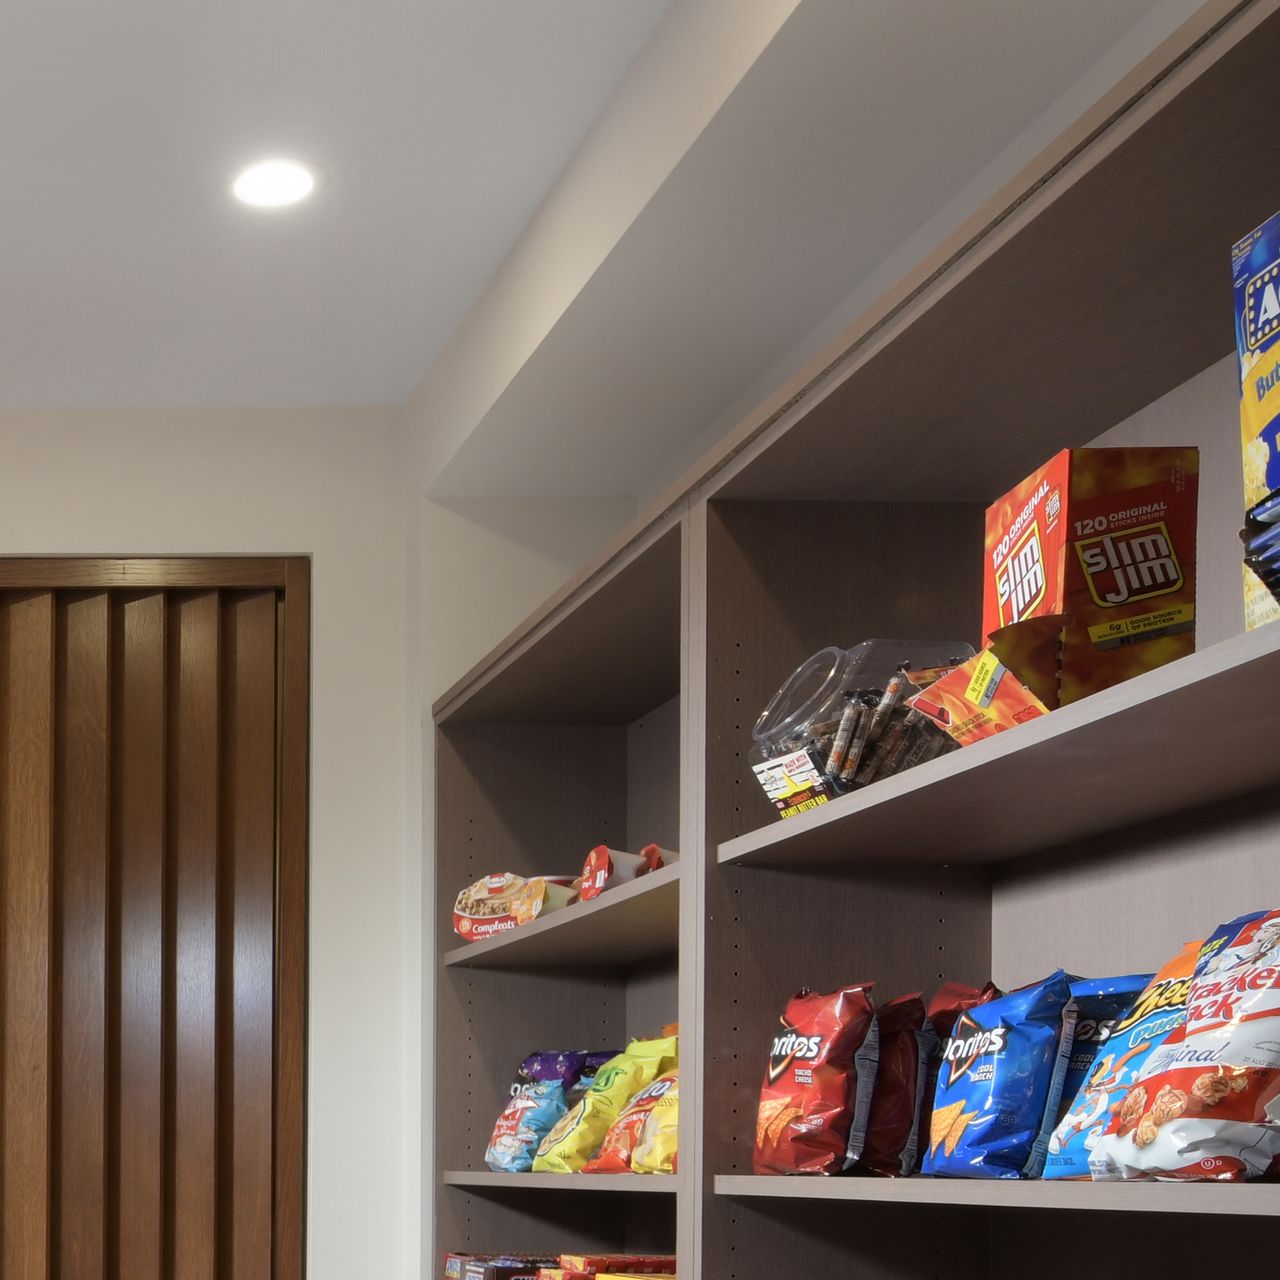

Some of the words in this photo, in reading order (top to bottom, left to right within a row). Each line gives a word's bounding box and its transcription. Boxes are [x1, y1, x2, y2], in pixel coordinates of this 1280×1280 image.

[992, 535, 1010, 569] 120
[1009, 480, 1050, 538] ORIGINAL
[1074, 516, 1107, 536] 120
[1109, 502, 1167, 521] ORIGINAL
[1110, 517, 1136, 528] STICKS
[1139, 511, 1165, 521] INSIDE
[1109, 623, 1121, 633] 6g
[1129, 616, 1151, 625] GOOD
[1153, 609, 1182, 620] SOURCE
[1131, 623, 1141, 631] OF
[1143, 616, 1175, 628] PROTEIN
[472, 920, 516, 934] Compleats
[1189, 990, 1244, 1022] ack
[977, 1064, 994, 1073] COOL
[795, 1076, 813, 1084] CHEESE
